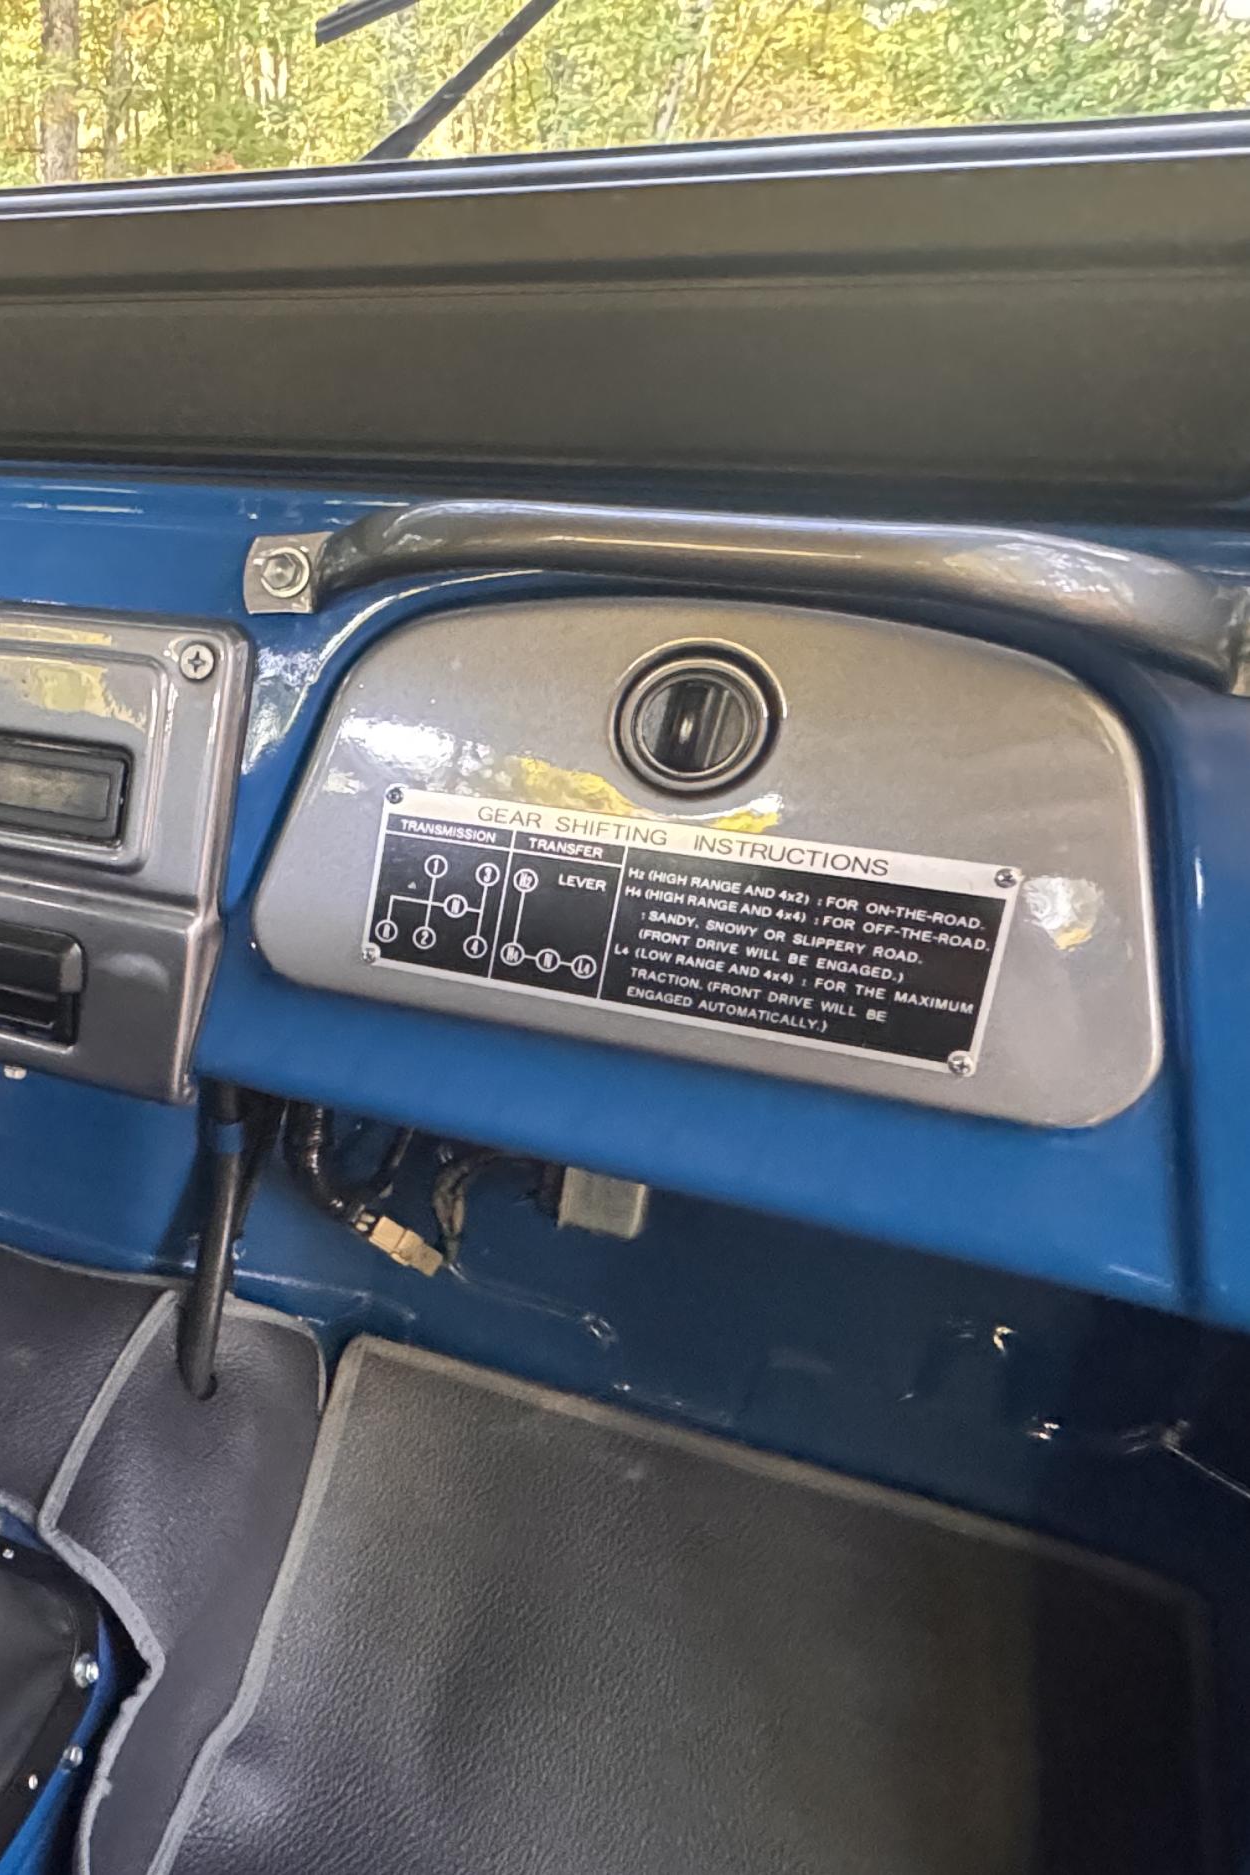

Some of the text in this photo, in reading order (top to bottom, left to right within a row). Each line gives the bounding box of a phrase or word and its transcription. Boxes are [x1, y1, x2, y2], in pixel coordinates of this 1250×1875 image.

[400, 819, 496, 843] TRANSMISSION
[477, 806, 890, 876] GEAR SHIFTING INSTRUCTIONS
[528, 837, 604, 859] TRANSFER
[518, 873, 533, 889] H2
[558, 873, 607, 892] LEVER
[628, 867, 645, 880] H2
[648, 870, 688, 886] (HIGH
[690, 876, 742, 894] RANGE
[744, 885, 776, 899] AND
[778, 890, 810, 905] 4x2)
[625, 885, 642, 898] H4
[645, 888, 684, 904] (HIGH
[687, 895, 739, 913] RANGE
[739, 903, 772, 917] AND
[775, 909, 806, 923] 4x4)
[862, 922, 990, 952] OFF-THE-ROAD.
[638, 928, 904, 983] (FRONT DRIVE WILL BE ENGAGED.)
[705, 919, 758, 937] SNOWY
[764, 929, 786, 942] OR
[792, 933, 866, 955] SLIPPERY
[872, 945, 923, 965] ROAD.
[577, 959, 591, 975] L4
[614, 943, 629, 955] L4
[635, 947, 672, 963] (LOW
[675, 954, 725, 972] RANGE
[728, 963, 760, 978] AND
[763, 970, 794, 985] 4x4)
[814, 977, 847, 993] FOR
[854, 983, 887, 1000] THE
[893, 990, 975, 1014] MAXIMUM
[626, 986, 828, 1033] ENGAGED AUTOMATICALLY.)
[631, 967, 887, 1022] TRACTION. (FRONT DRIVE WILL BE
